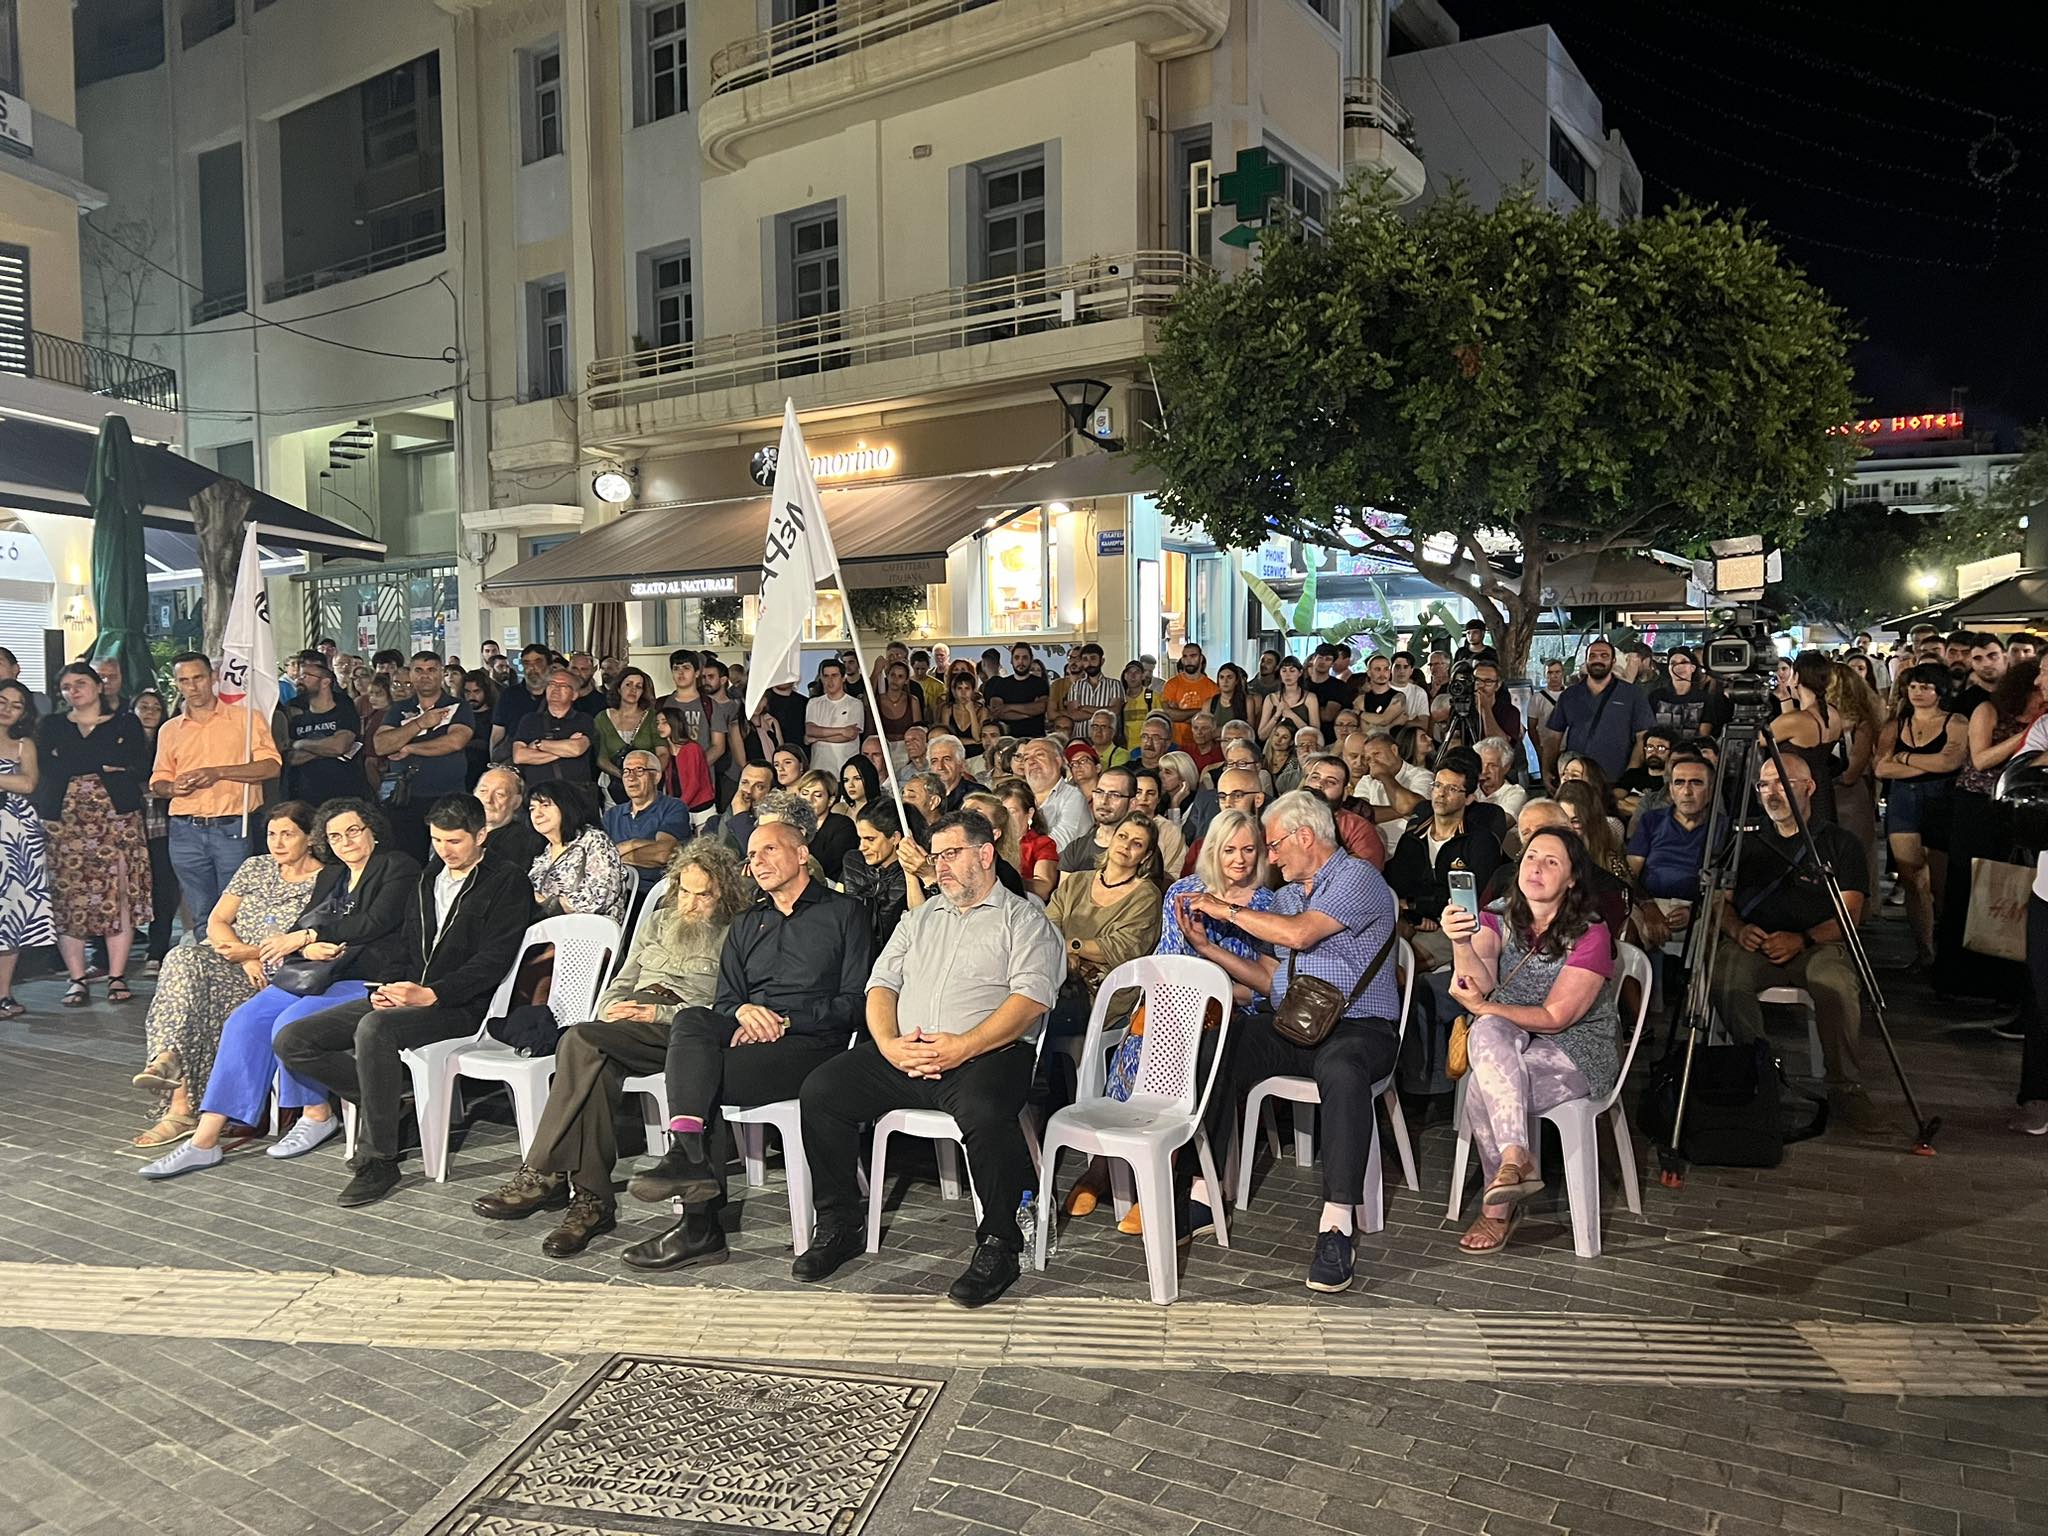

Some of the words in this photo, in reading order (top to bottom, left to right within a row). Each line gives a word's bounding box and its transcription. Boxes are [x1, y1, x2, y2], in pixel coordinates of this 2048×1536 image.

[1892, 412, 1963, 432] HOTEL
[811, 442, 891, 476] morino
[1265, 549, 1285, 563] PHONE
[1263, 564, 1287, 579] SERVICE
[630, 582, 667, 595] GELATO
[667, 581, 680, 593] AL
[681, 578, 734, 593] NATURALE
[1560, 585, 1657, 605] Amorino
[314, 721, 337, 731] KING
[634, 1467, 682, 1483] ΚΠΣ
[713, 1475, 802, 1494] ΔΙΚΤΥΟ
[548, 1473, 691, 1499] ΕΥΡΥΖΩΝΙΚΟ
[699, 1488, 821, 1513] ΕΛΛΗΝΙΚΟ
